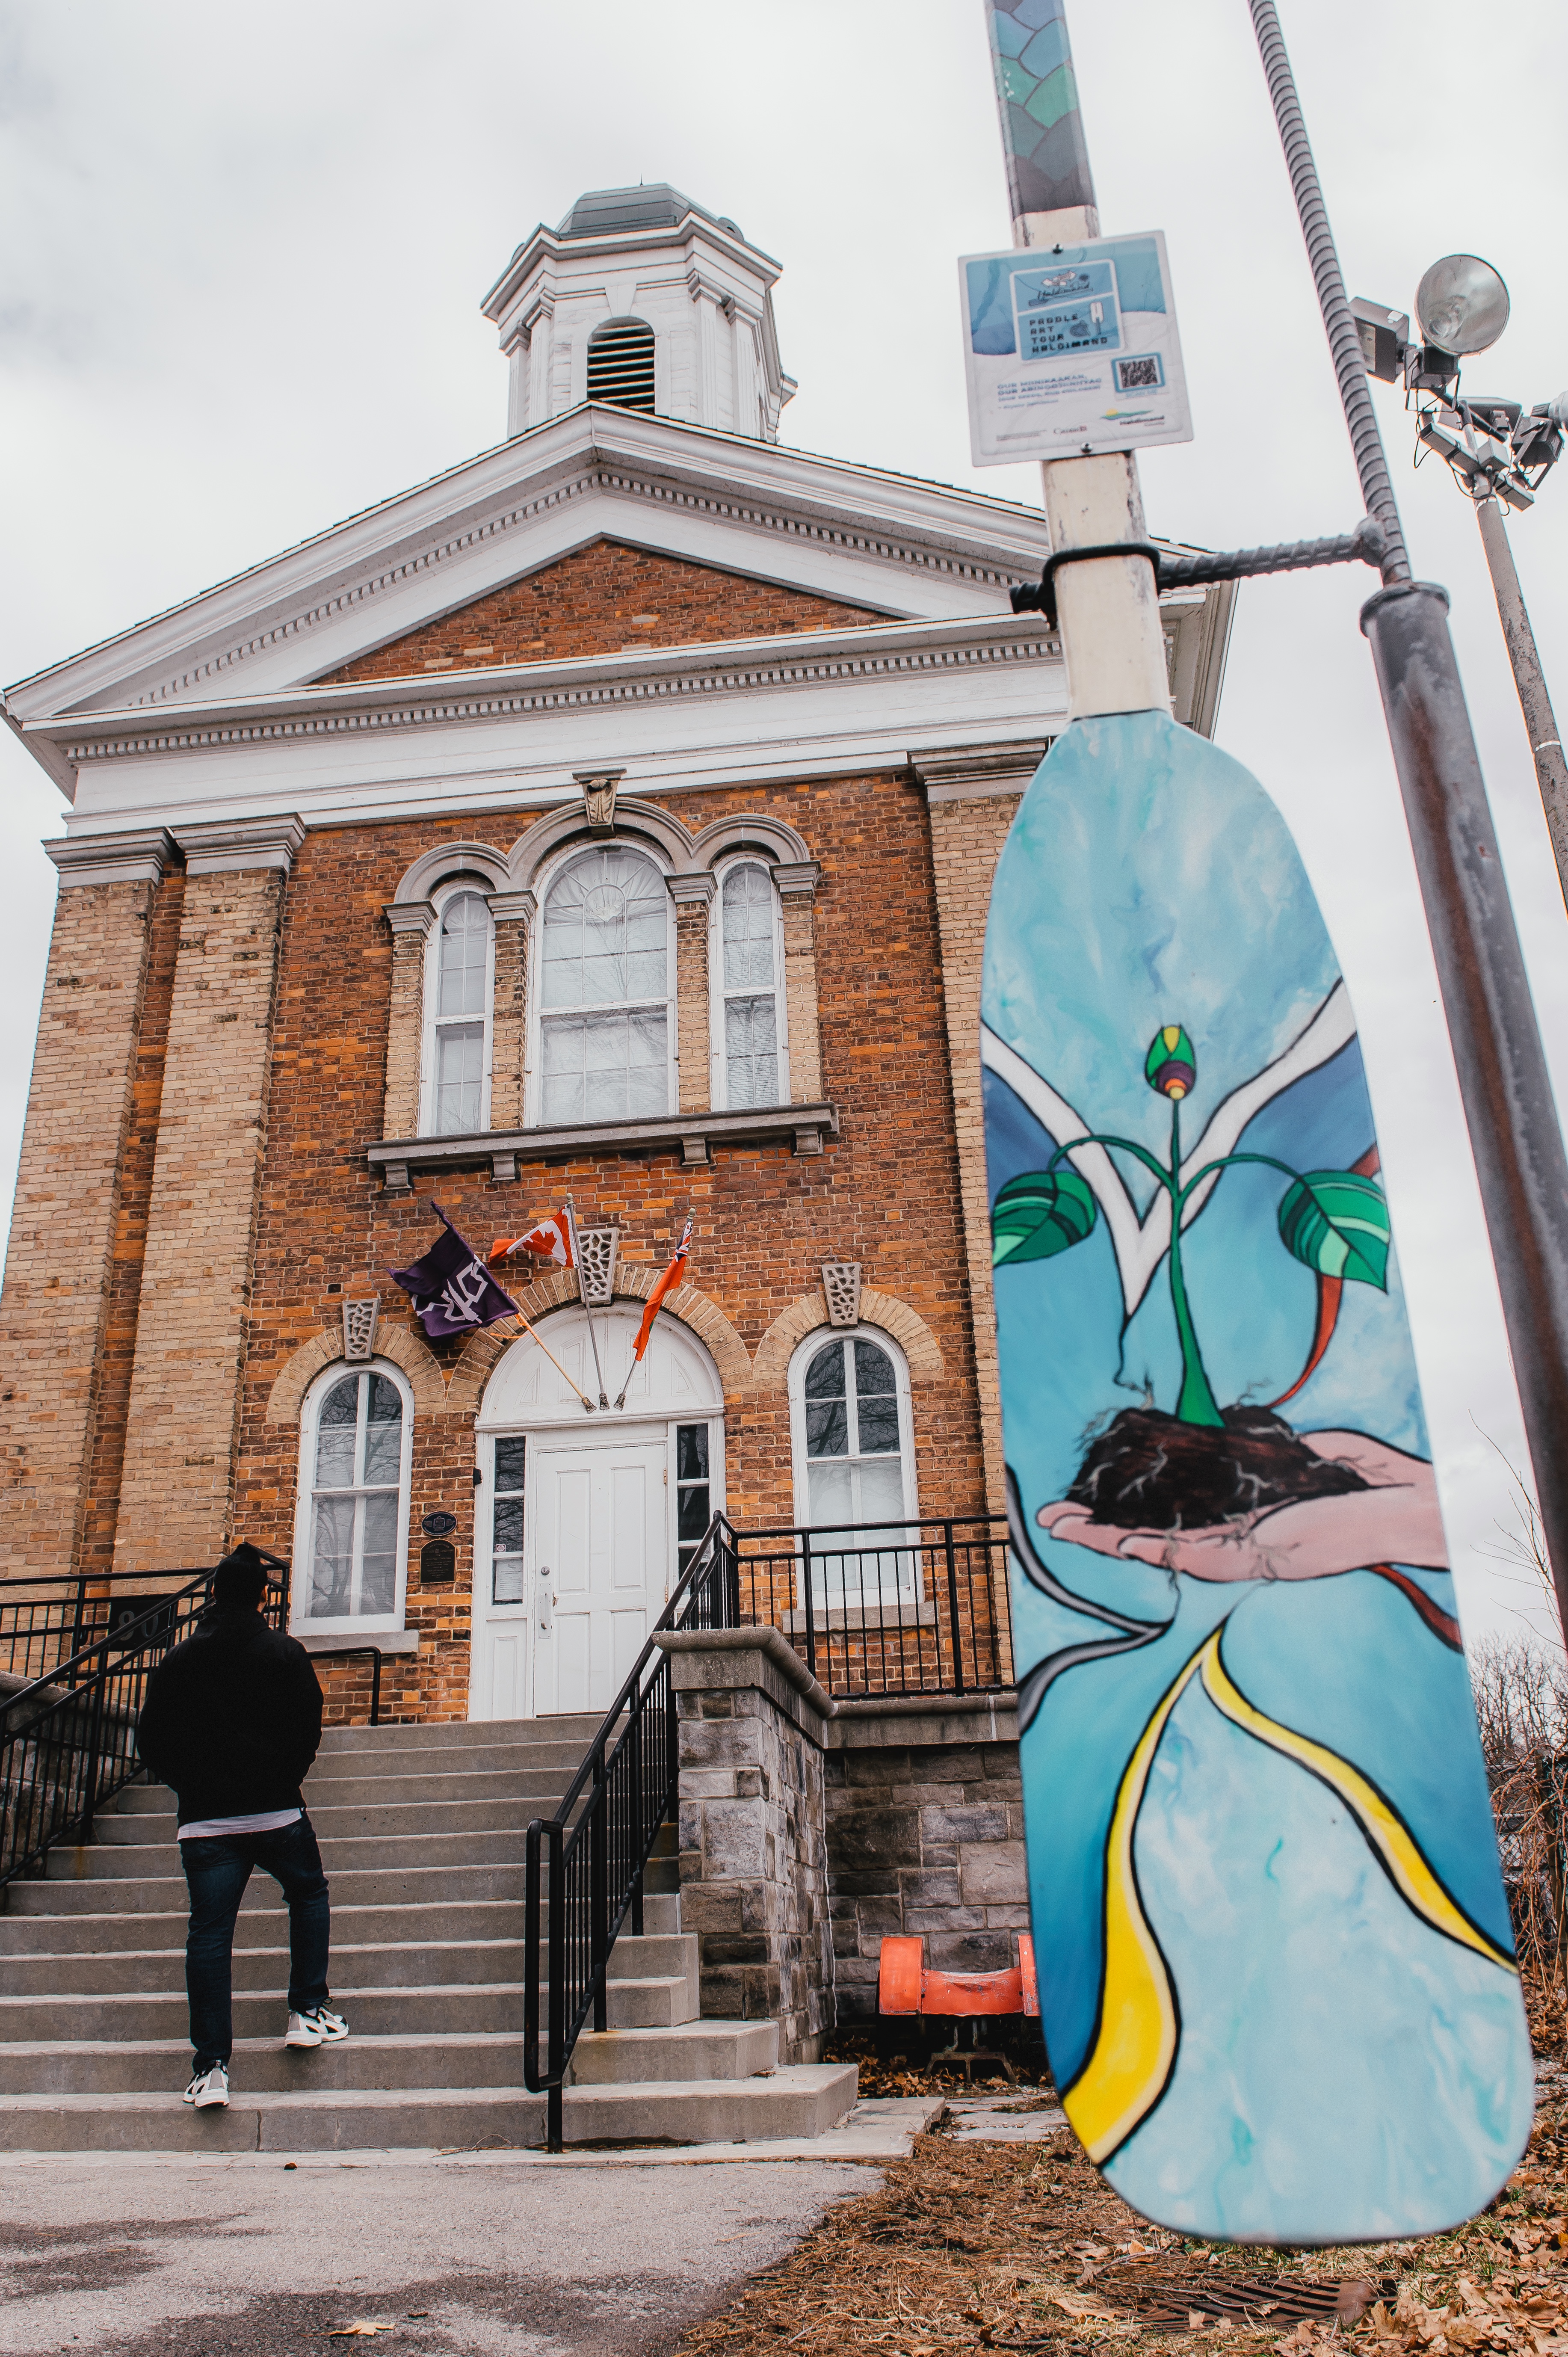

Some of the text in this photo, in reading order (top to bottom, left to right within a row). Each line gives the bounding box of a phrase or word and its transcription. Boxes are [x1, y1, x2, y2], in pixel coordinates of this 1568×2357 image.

[1030, 314, 1077, 325] PADDLE
[1030, 326, 1054, 335] ART
[1031, 333, 1064, 344] TOUR
[1032, 337, 1107, 353] HALDIMAND
